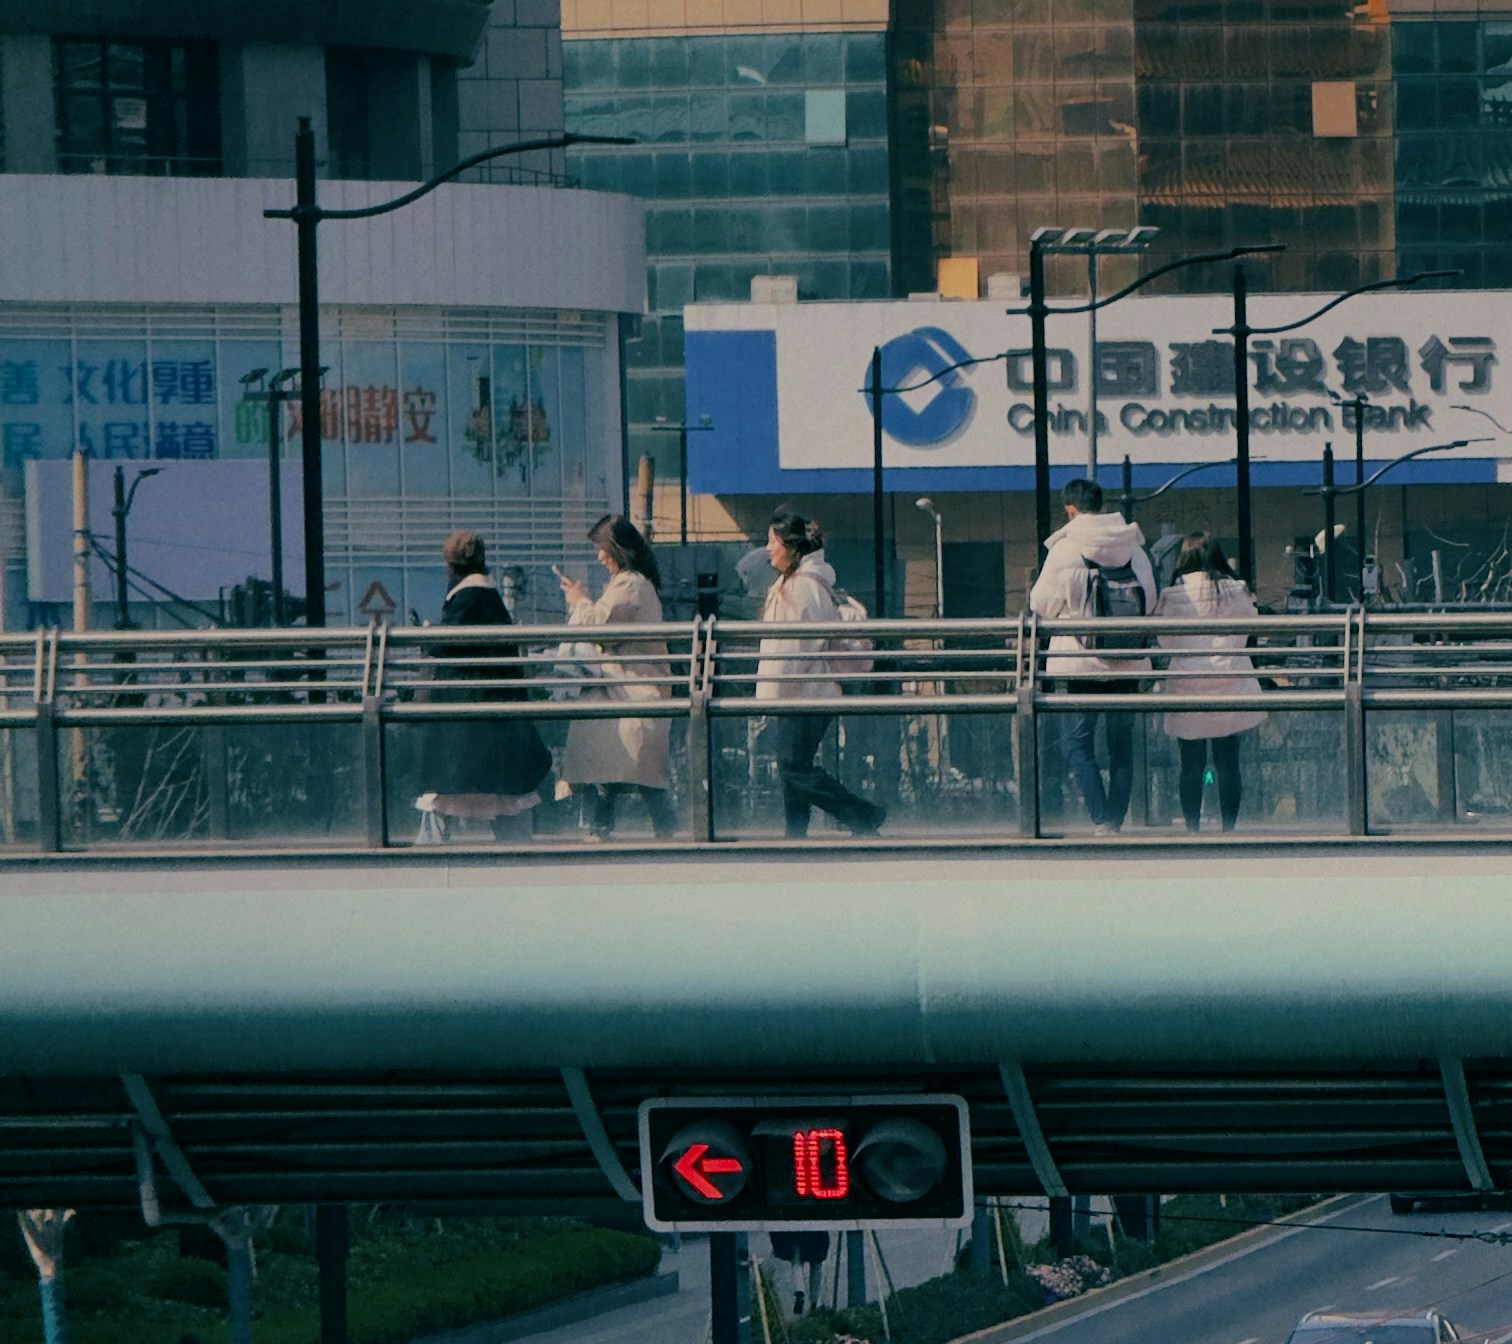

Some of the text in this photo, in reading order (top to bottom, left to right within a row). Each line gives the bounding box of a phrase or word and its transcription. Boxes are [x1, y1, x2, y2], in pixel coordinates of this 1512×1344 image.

[1007, 334, 1496, 395] 中国建设银行
[1342, 398, 1433, 432] Bank
[794, 1129, 849, 1199] 10
